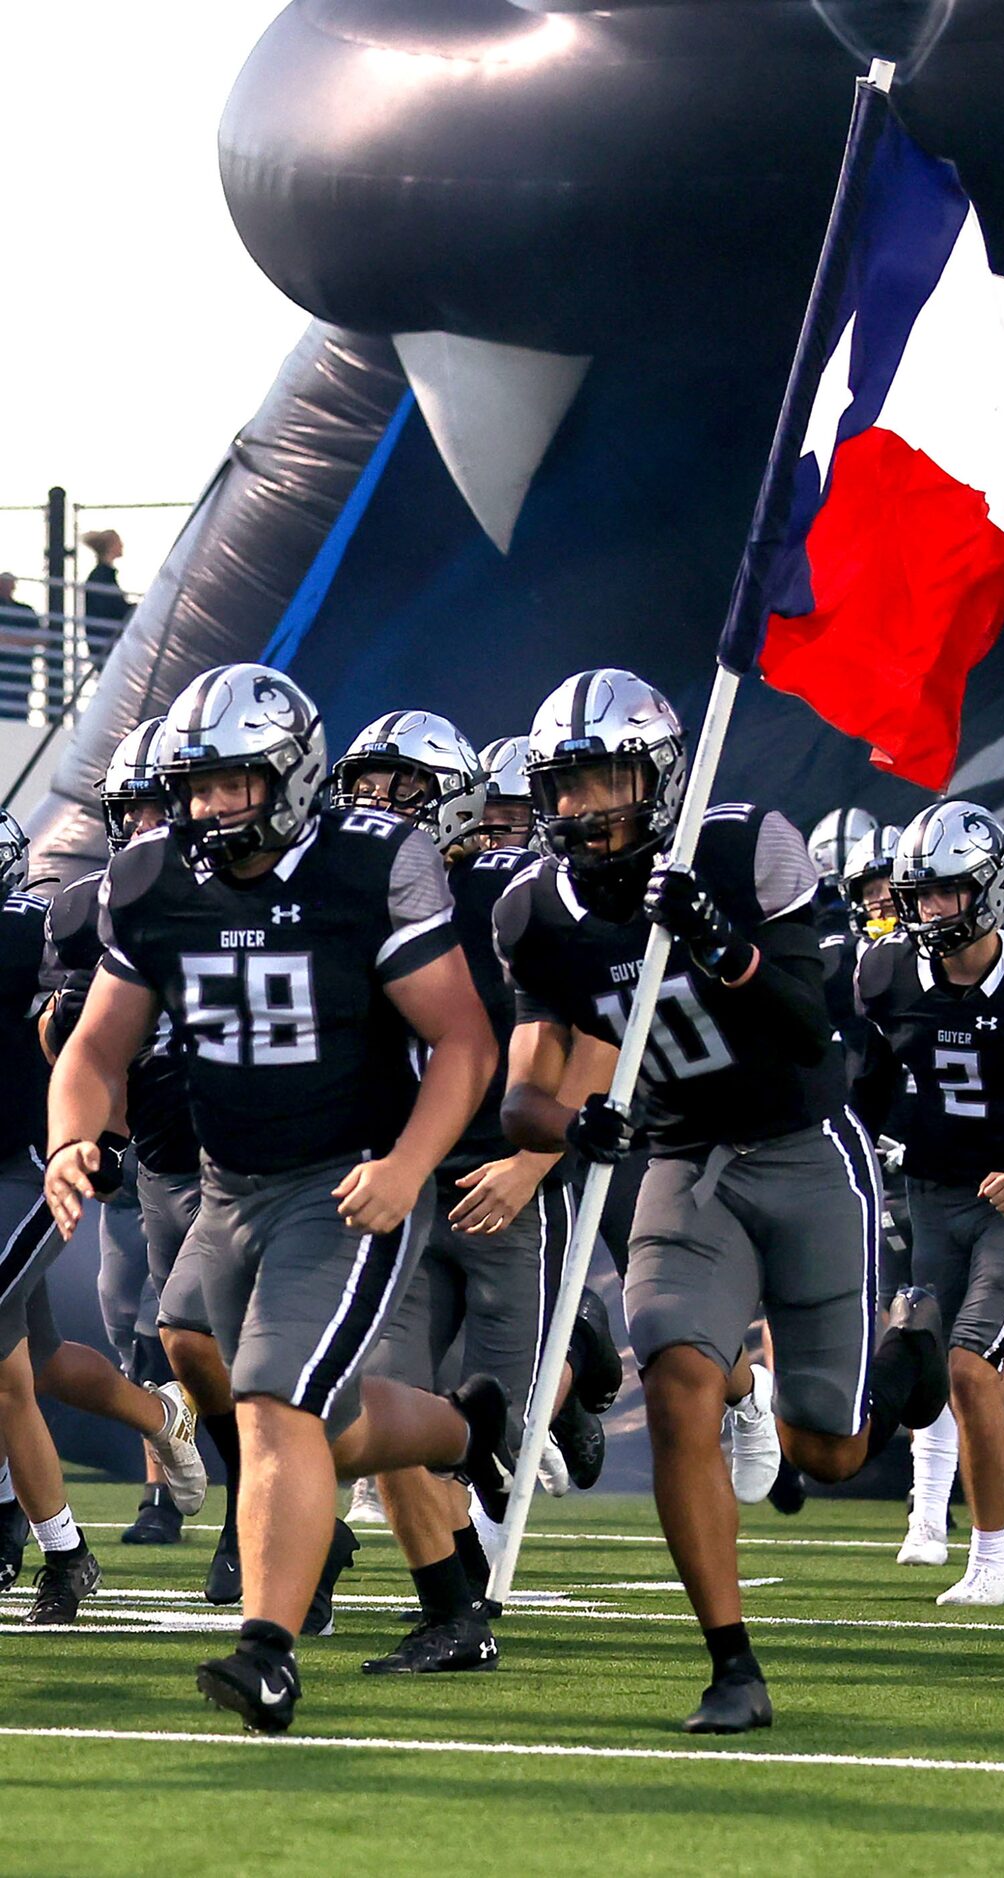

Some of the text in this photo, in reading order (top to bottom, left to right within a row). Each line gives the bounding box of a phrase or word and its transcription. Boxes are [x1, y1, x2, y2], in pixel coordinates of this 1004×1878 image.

[220, 930, 266, 948] GUYER
[610, 958, 645, 984] GUYE
[180, 952, 320, 1066] 58
[594, 972, 737, 1083] 10
[937, 1029, 972, 1045] GUYER
[933, 1048, 987, 1118] 2
